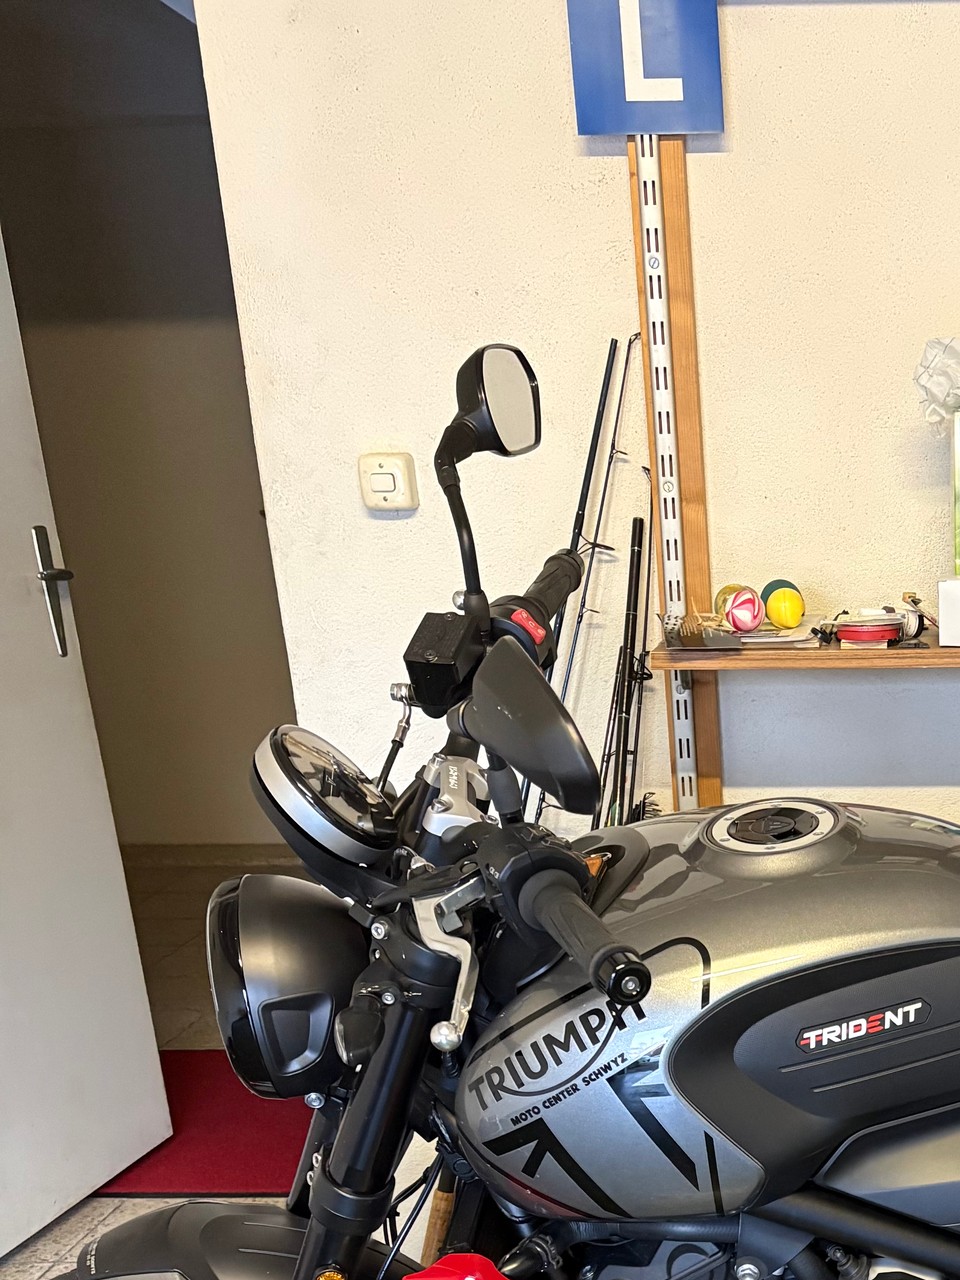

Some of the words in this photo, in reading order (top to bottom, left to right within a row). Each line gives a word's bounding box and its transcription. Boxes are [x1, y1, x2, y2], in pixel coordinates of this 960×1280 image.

[467, 1000, 647, 1112] TRIUMPH
[800, 1002, 923, 1050] TRIDENT
[510, 1105, 541, 1127] MOTO
[541, 1084, 581, 1110] CENTER
[581, 1052, 628, 1087] SCHWYZ
